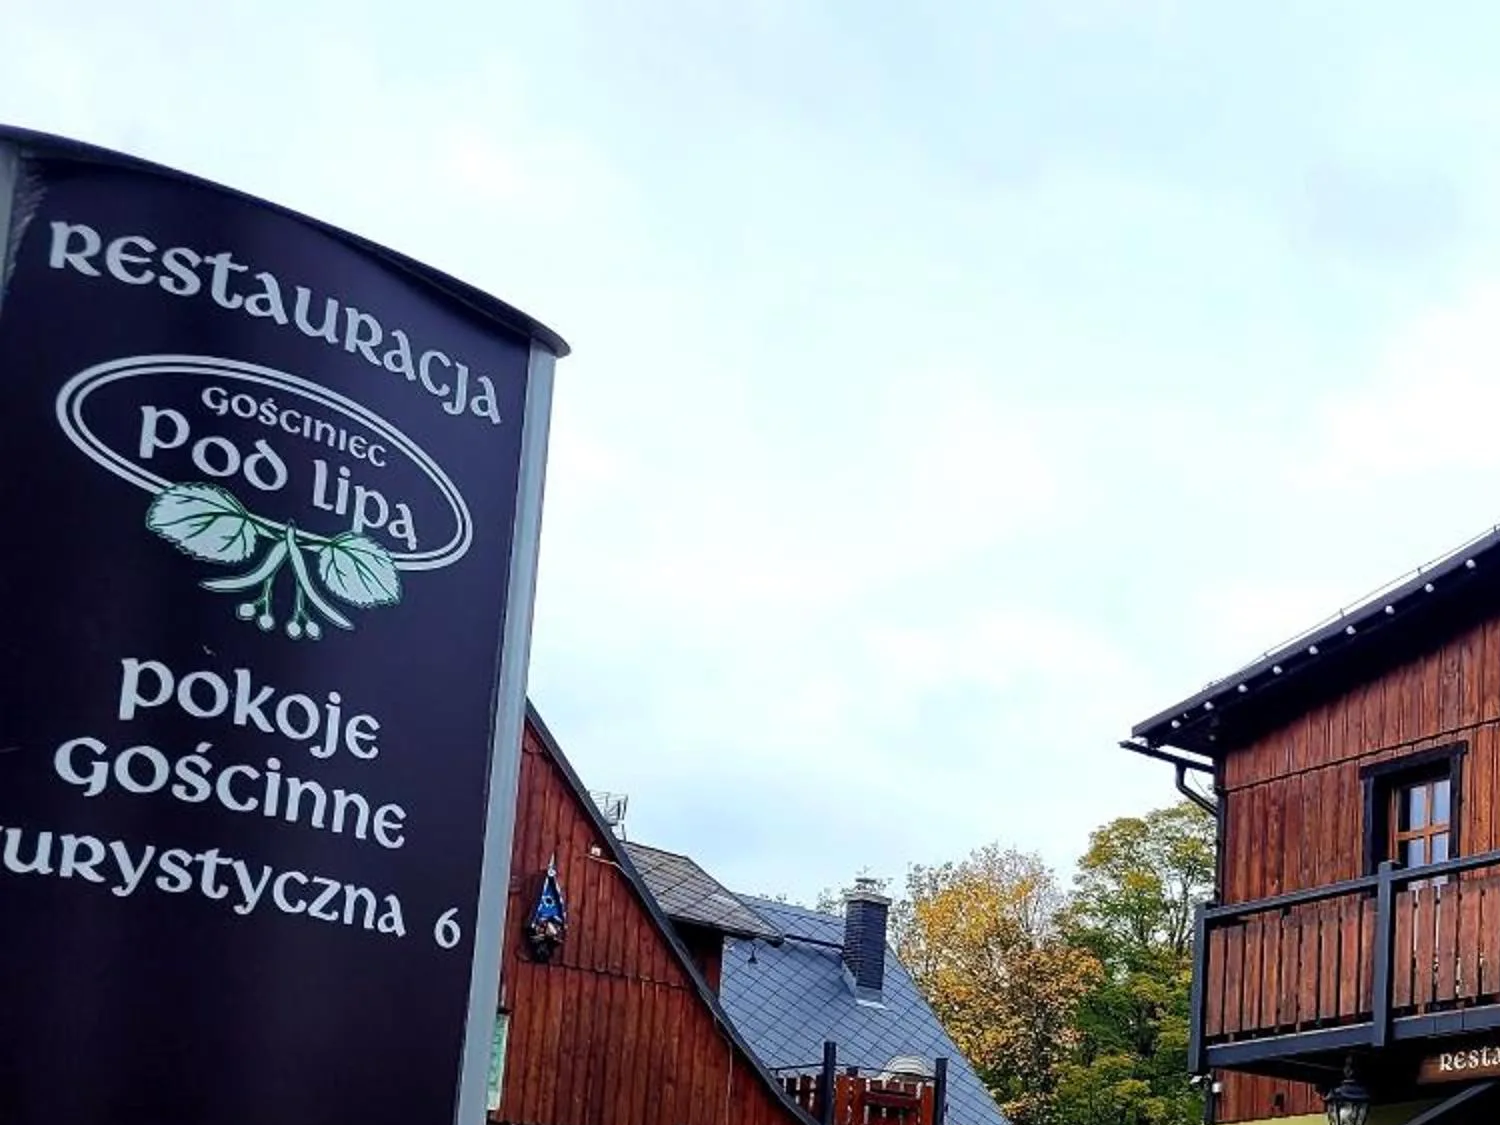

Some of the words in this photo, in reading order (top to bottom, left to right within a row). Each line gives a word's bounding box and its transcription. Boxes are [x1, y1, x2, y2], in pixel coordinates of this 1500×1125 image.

[51, 221, 502, 425] RESTAURACJA
[0, 825, 406, 938] urystyczna
[434, 907, 461, 949] 6
